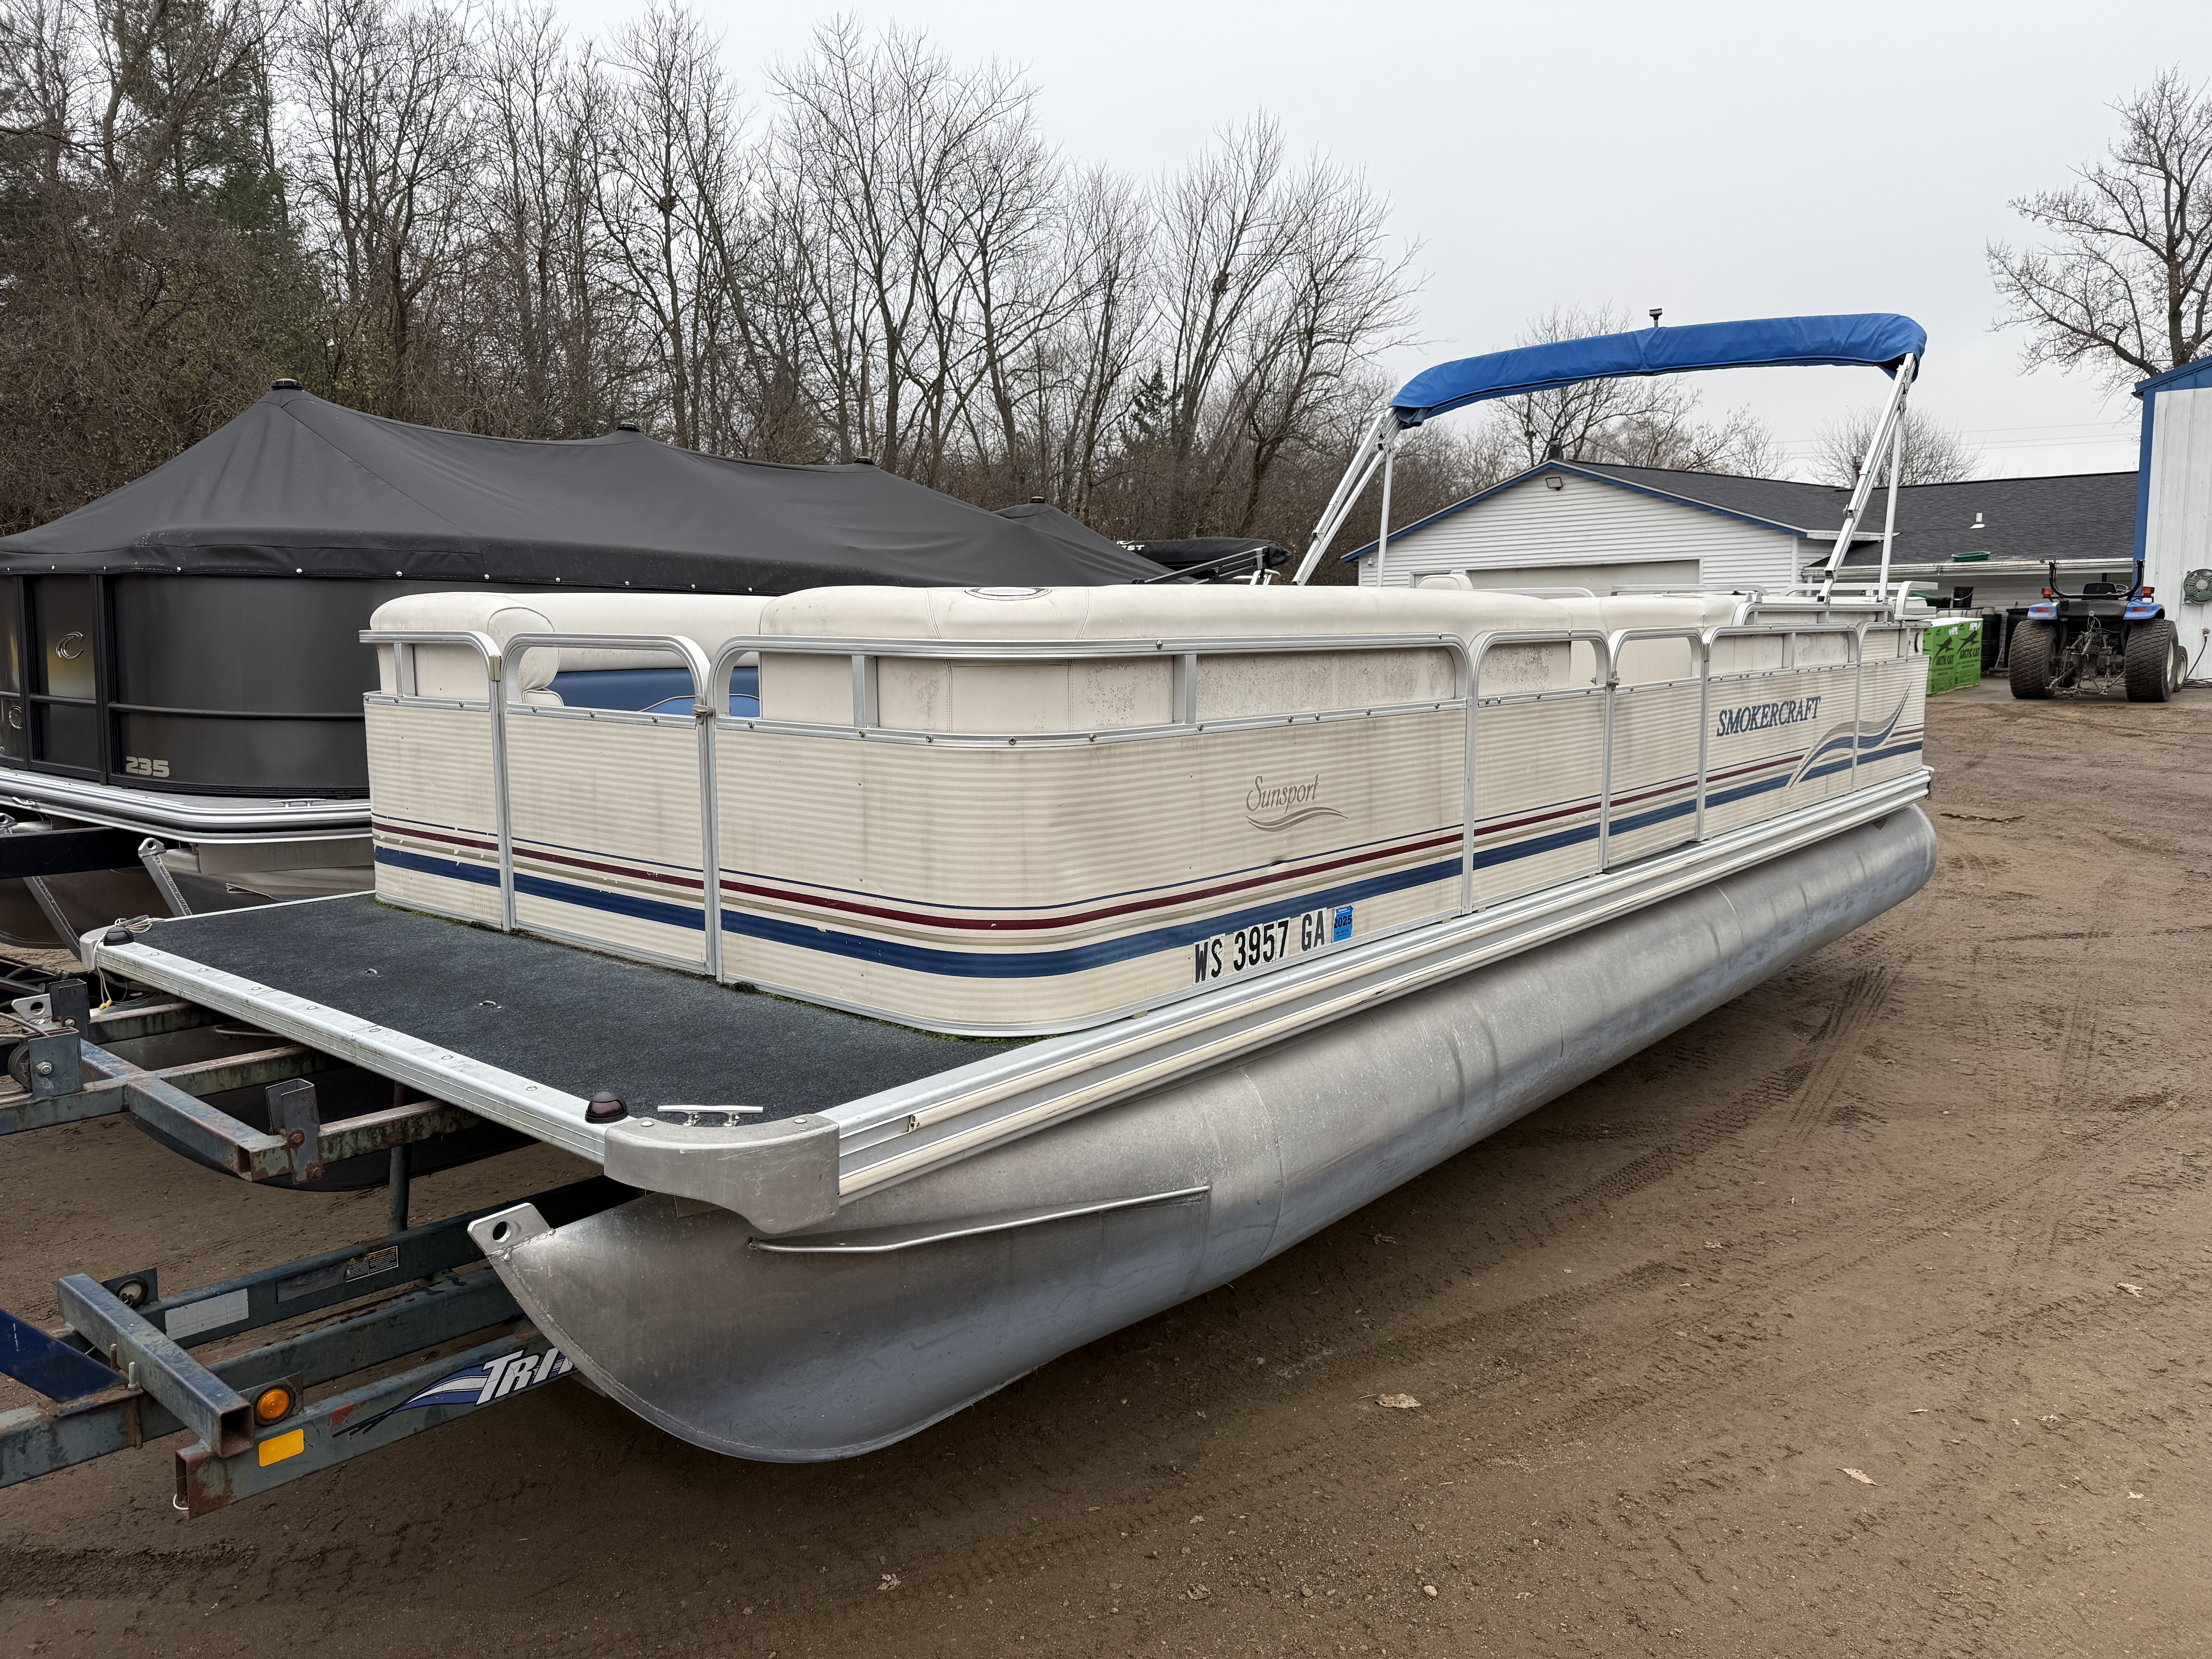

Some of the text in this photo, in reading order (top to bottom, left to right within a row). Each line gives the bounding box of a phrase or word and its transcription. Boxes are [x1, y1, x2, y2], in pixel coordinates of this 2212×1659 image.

[1717, 696, 1821, 737] SMOKERCRAFT
[126, 756, 170, 778] 235
[1246, 774, 1319, 814] Sunsport
[1334, 914, 1352, 929] 2025
[1195, 910, 1325, 983] WS 3957 GA
